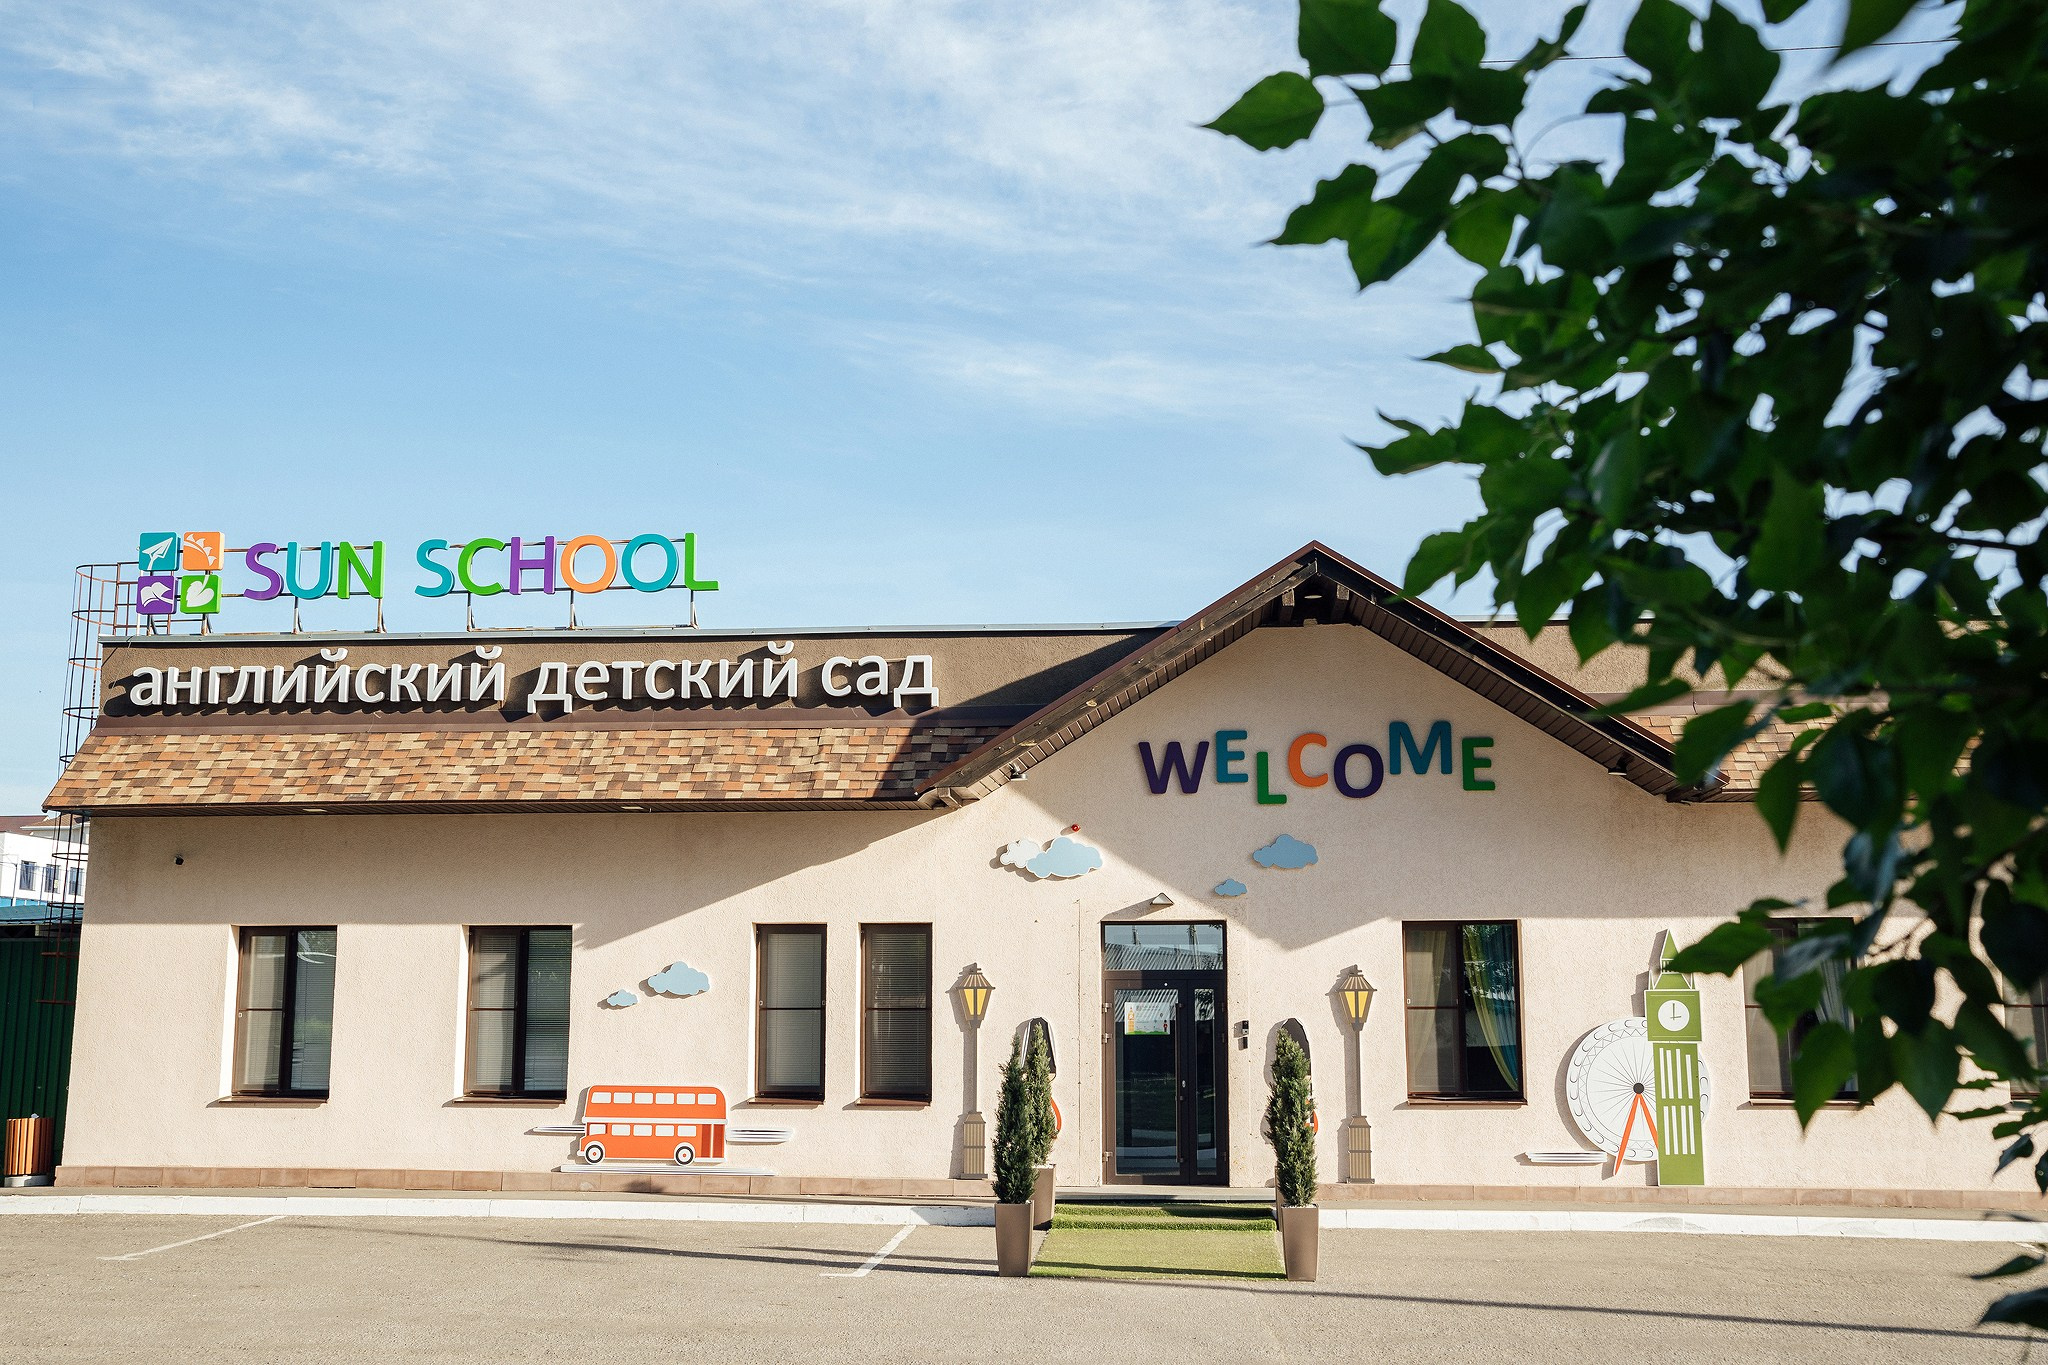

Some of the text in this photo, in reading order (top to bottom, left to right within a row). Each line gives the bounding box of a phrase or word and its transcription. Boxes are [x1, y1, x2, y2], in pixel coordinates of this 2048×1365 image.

[245, 533, 719, 599] SUN SCHOOL
[130, 641, 940, 714] английский детский сад
[1138, 720, 1496, 805] WELCOME
